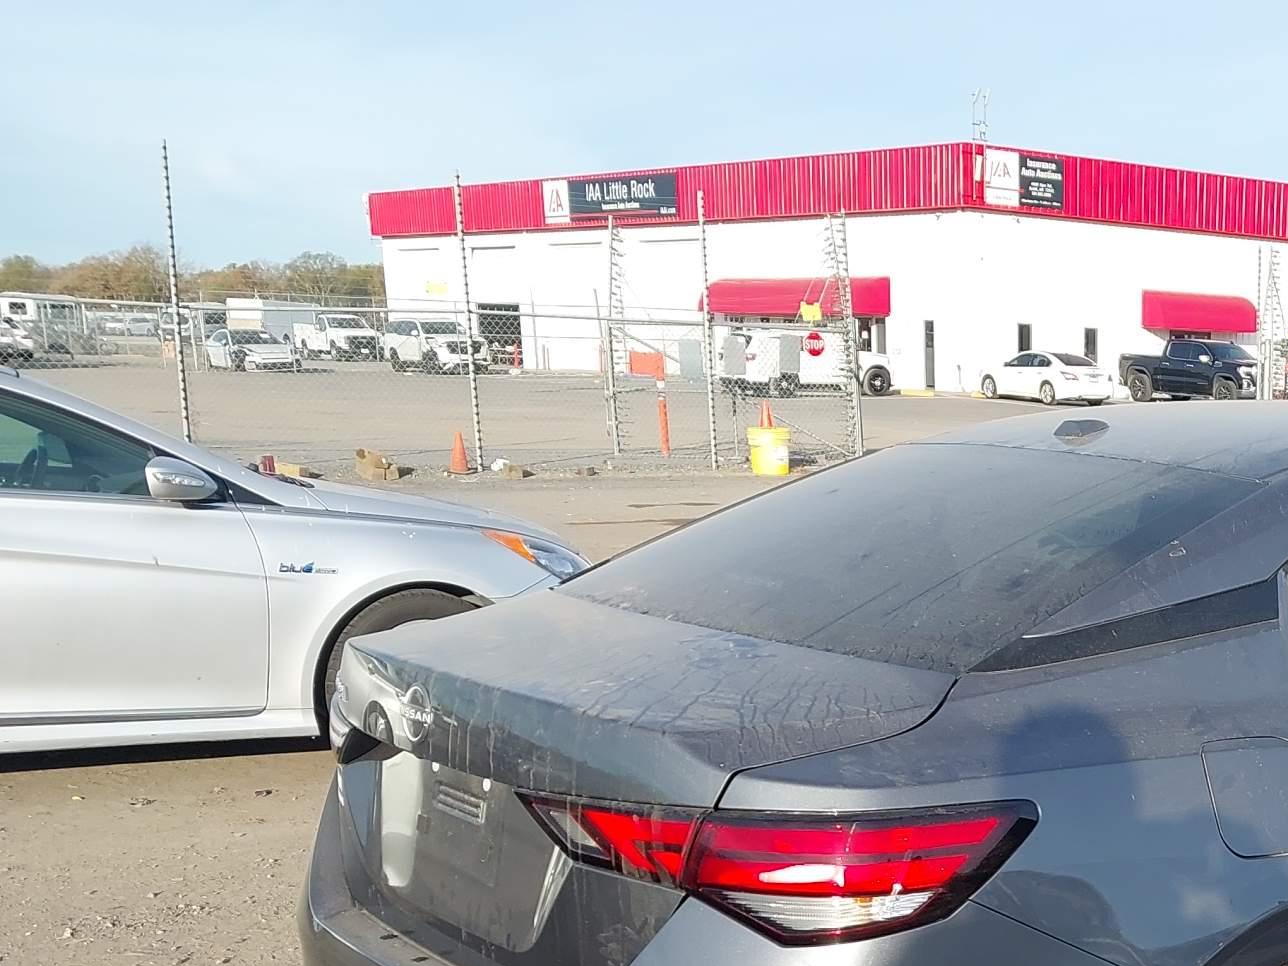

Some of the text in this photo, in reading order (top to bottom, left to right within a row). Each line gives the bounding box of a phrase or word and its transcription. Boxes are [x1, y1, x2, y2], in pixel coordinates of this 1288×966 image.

[585, 182, 601, 202] IAA
[603, 180, 628, 200] Little
[630, 179, 656, 199] Rock
[805, 339, 824, 350] STOP
